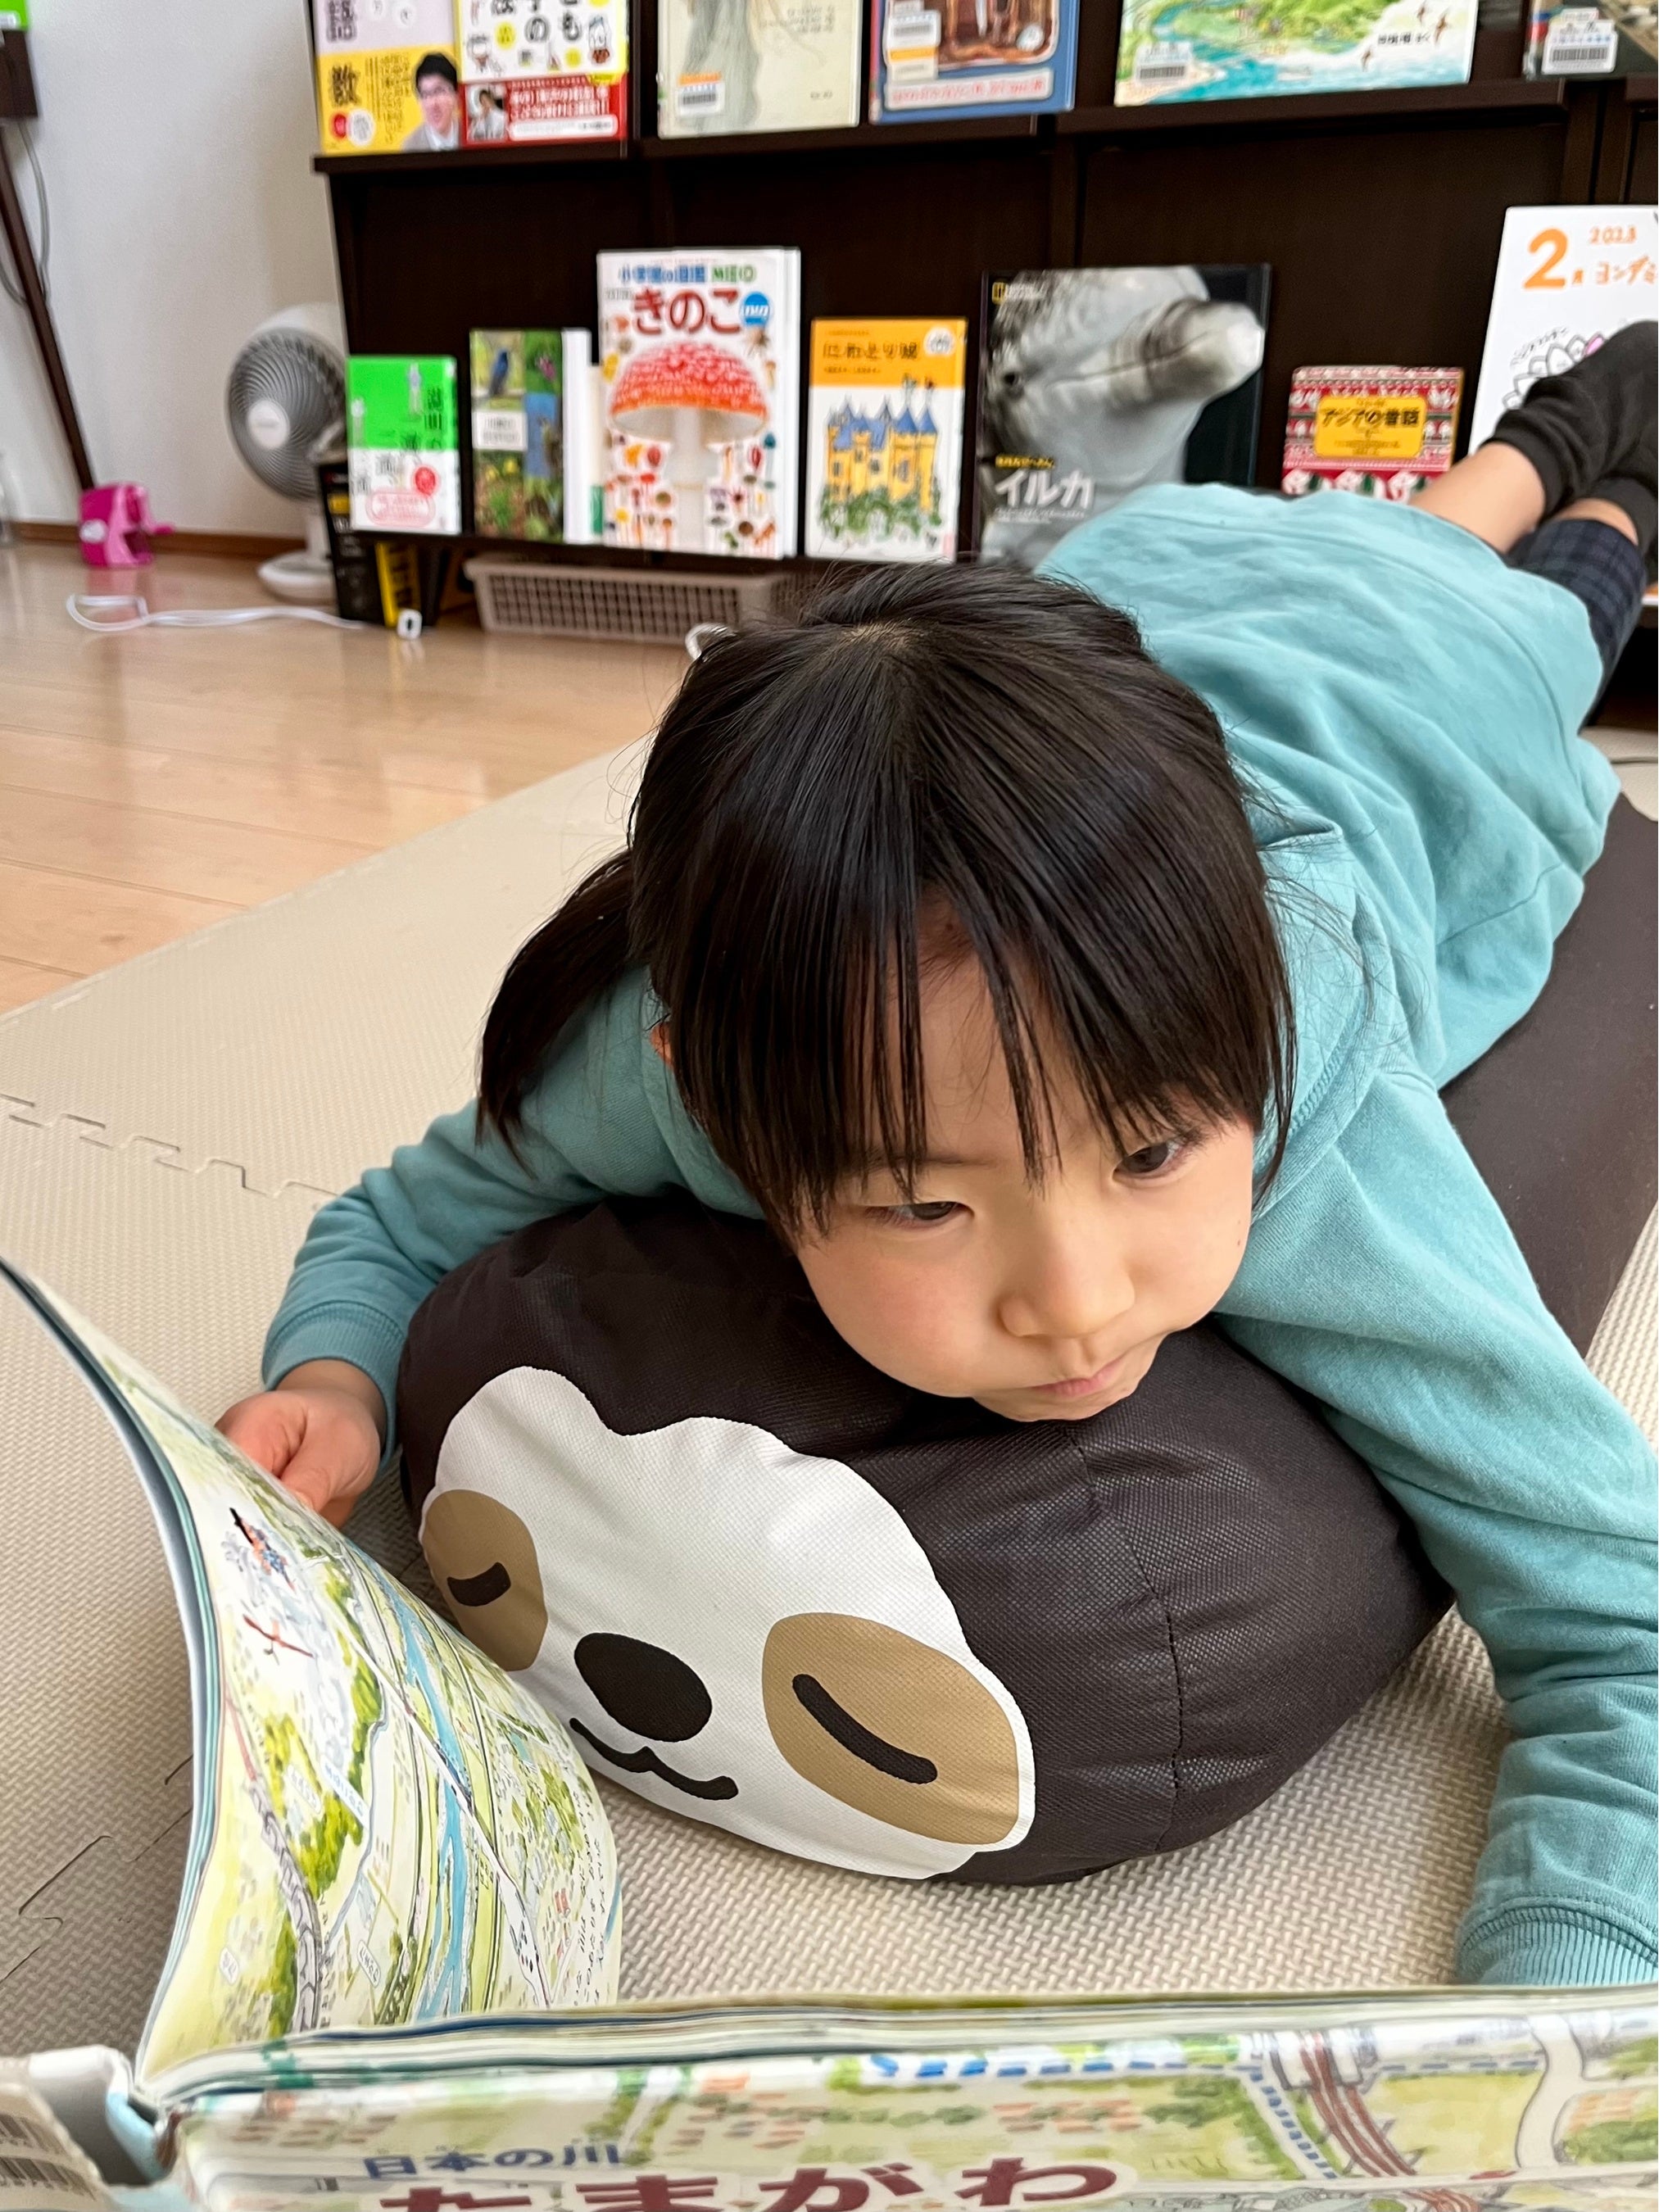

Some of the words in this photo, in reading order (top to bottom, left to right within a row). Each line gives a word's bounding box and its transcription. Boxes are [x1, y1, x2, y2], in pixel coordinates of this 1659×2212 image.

[633, 288, 741, 333] きのこ
[1321, 408, 1419, 427] アジアの昔話
[994, 469, 1095, 509] イルカ
[364, 2142, 619, 2179] 日本の川
